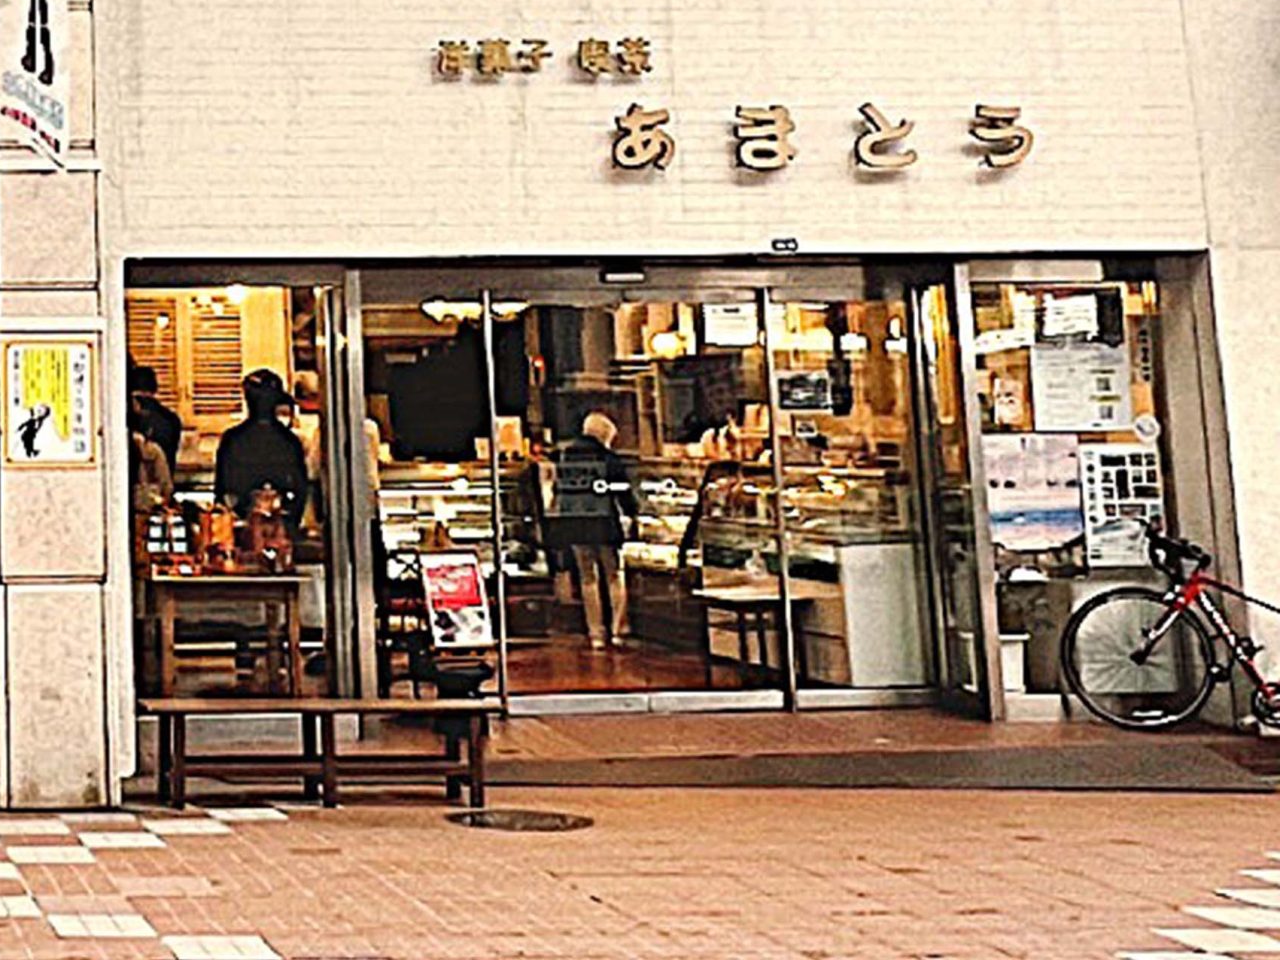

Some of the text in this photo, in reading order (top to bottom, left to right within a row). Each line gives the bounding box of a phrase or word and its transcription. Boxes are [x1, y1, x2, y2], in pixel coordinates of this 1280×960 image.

[436, 37, 654, 77] 洋菓子 喫茶
[612, 103, 1035, 172] あまとう
